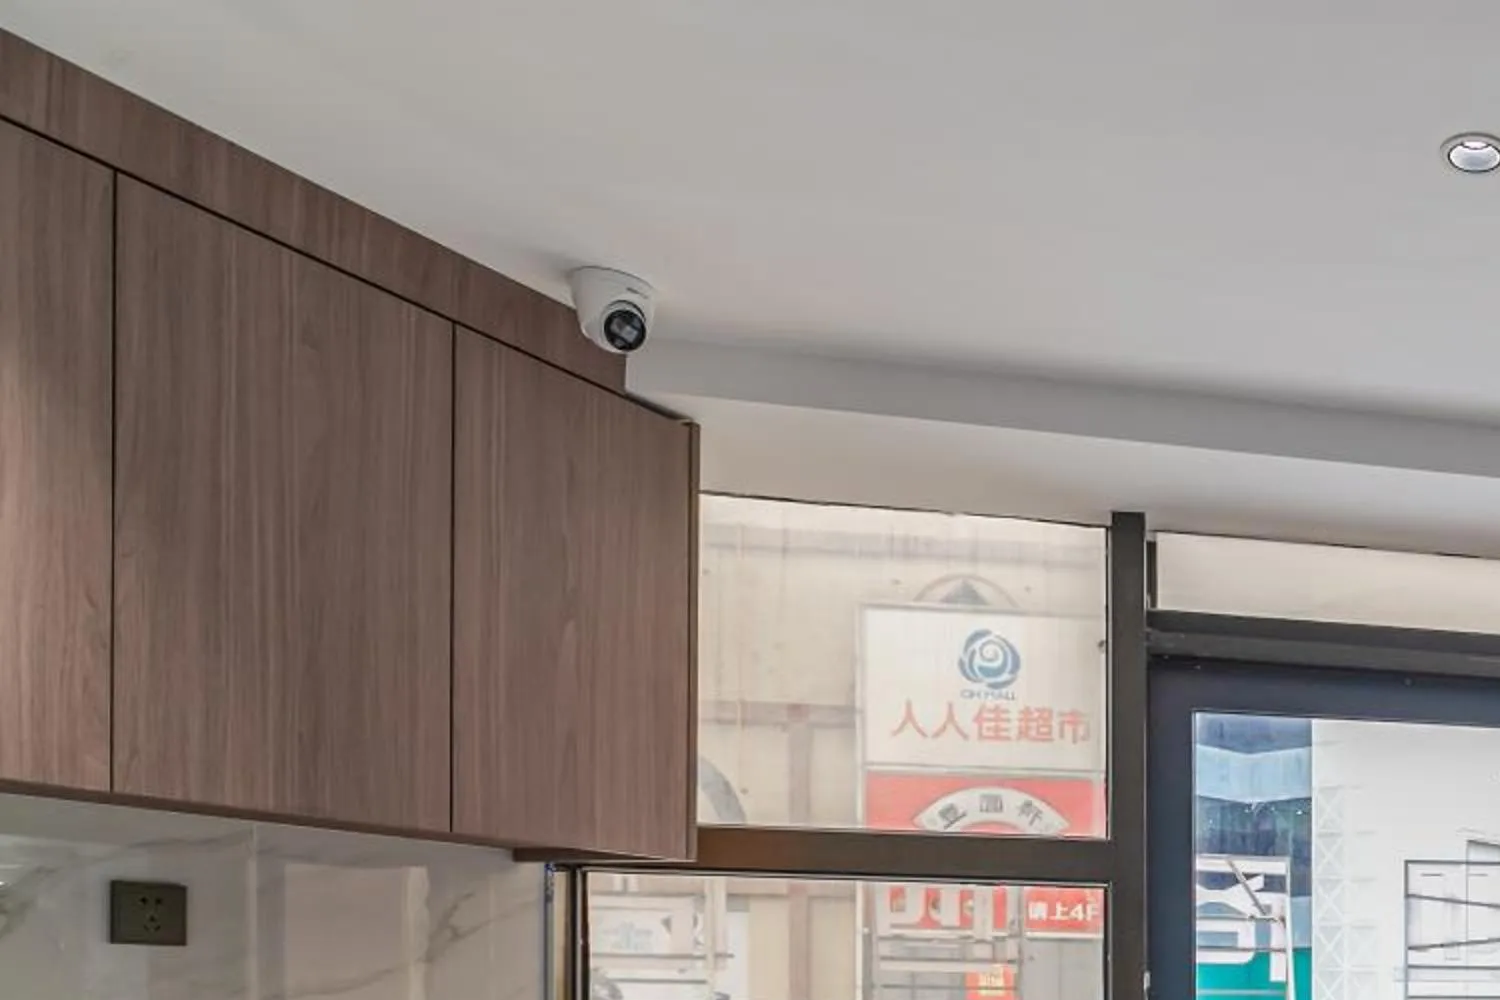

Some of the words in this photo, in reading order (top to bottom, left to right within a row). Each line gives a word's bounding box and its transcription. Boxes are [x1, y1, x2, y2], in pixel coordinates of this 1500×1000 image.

[891, 698, 1091, 744] 人人佳超市
